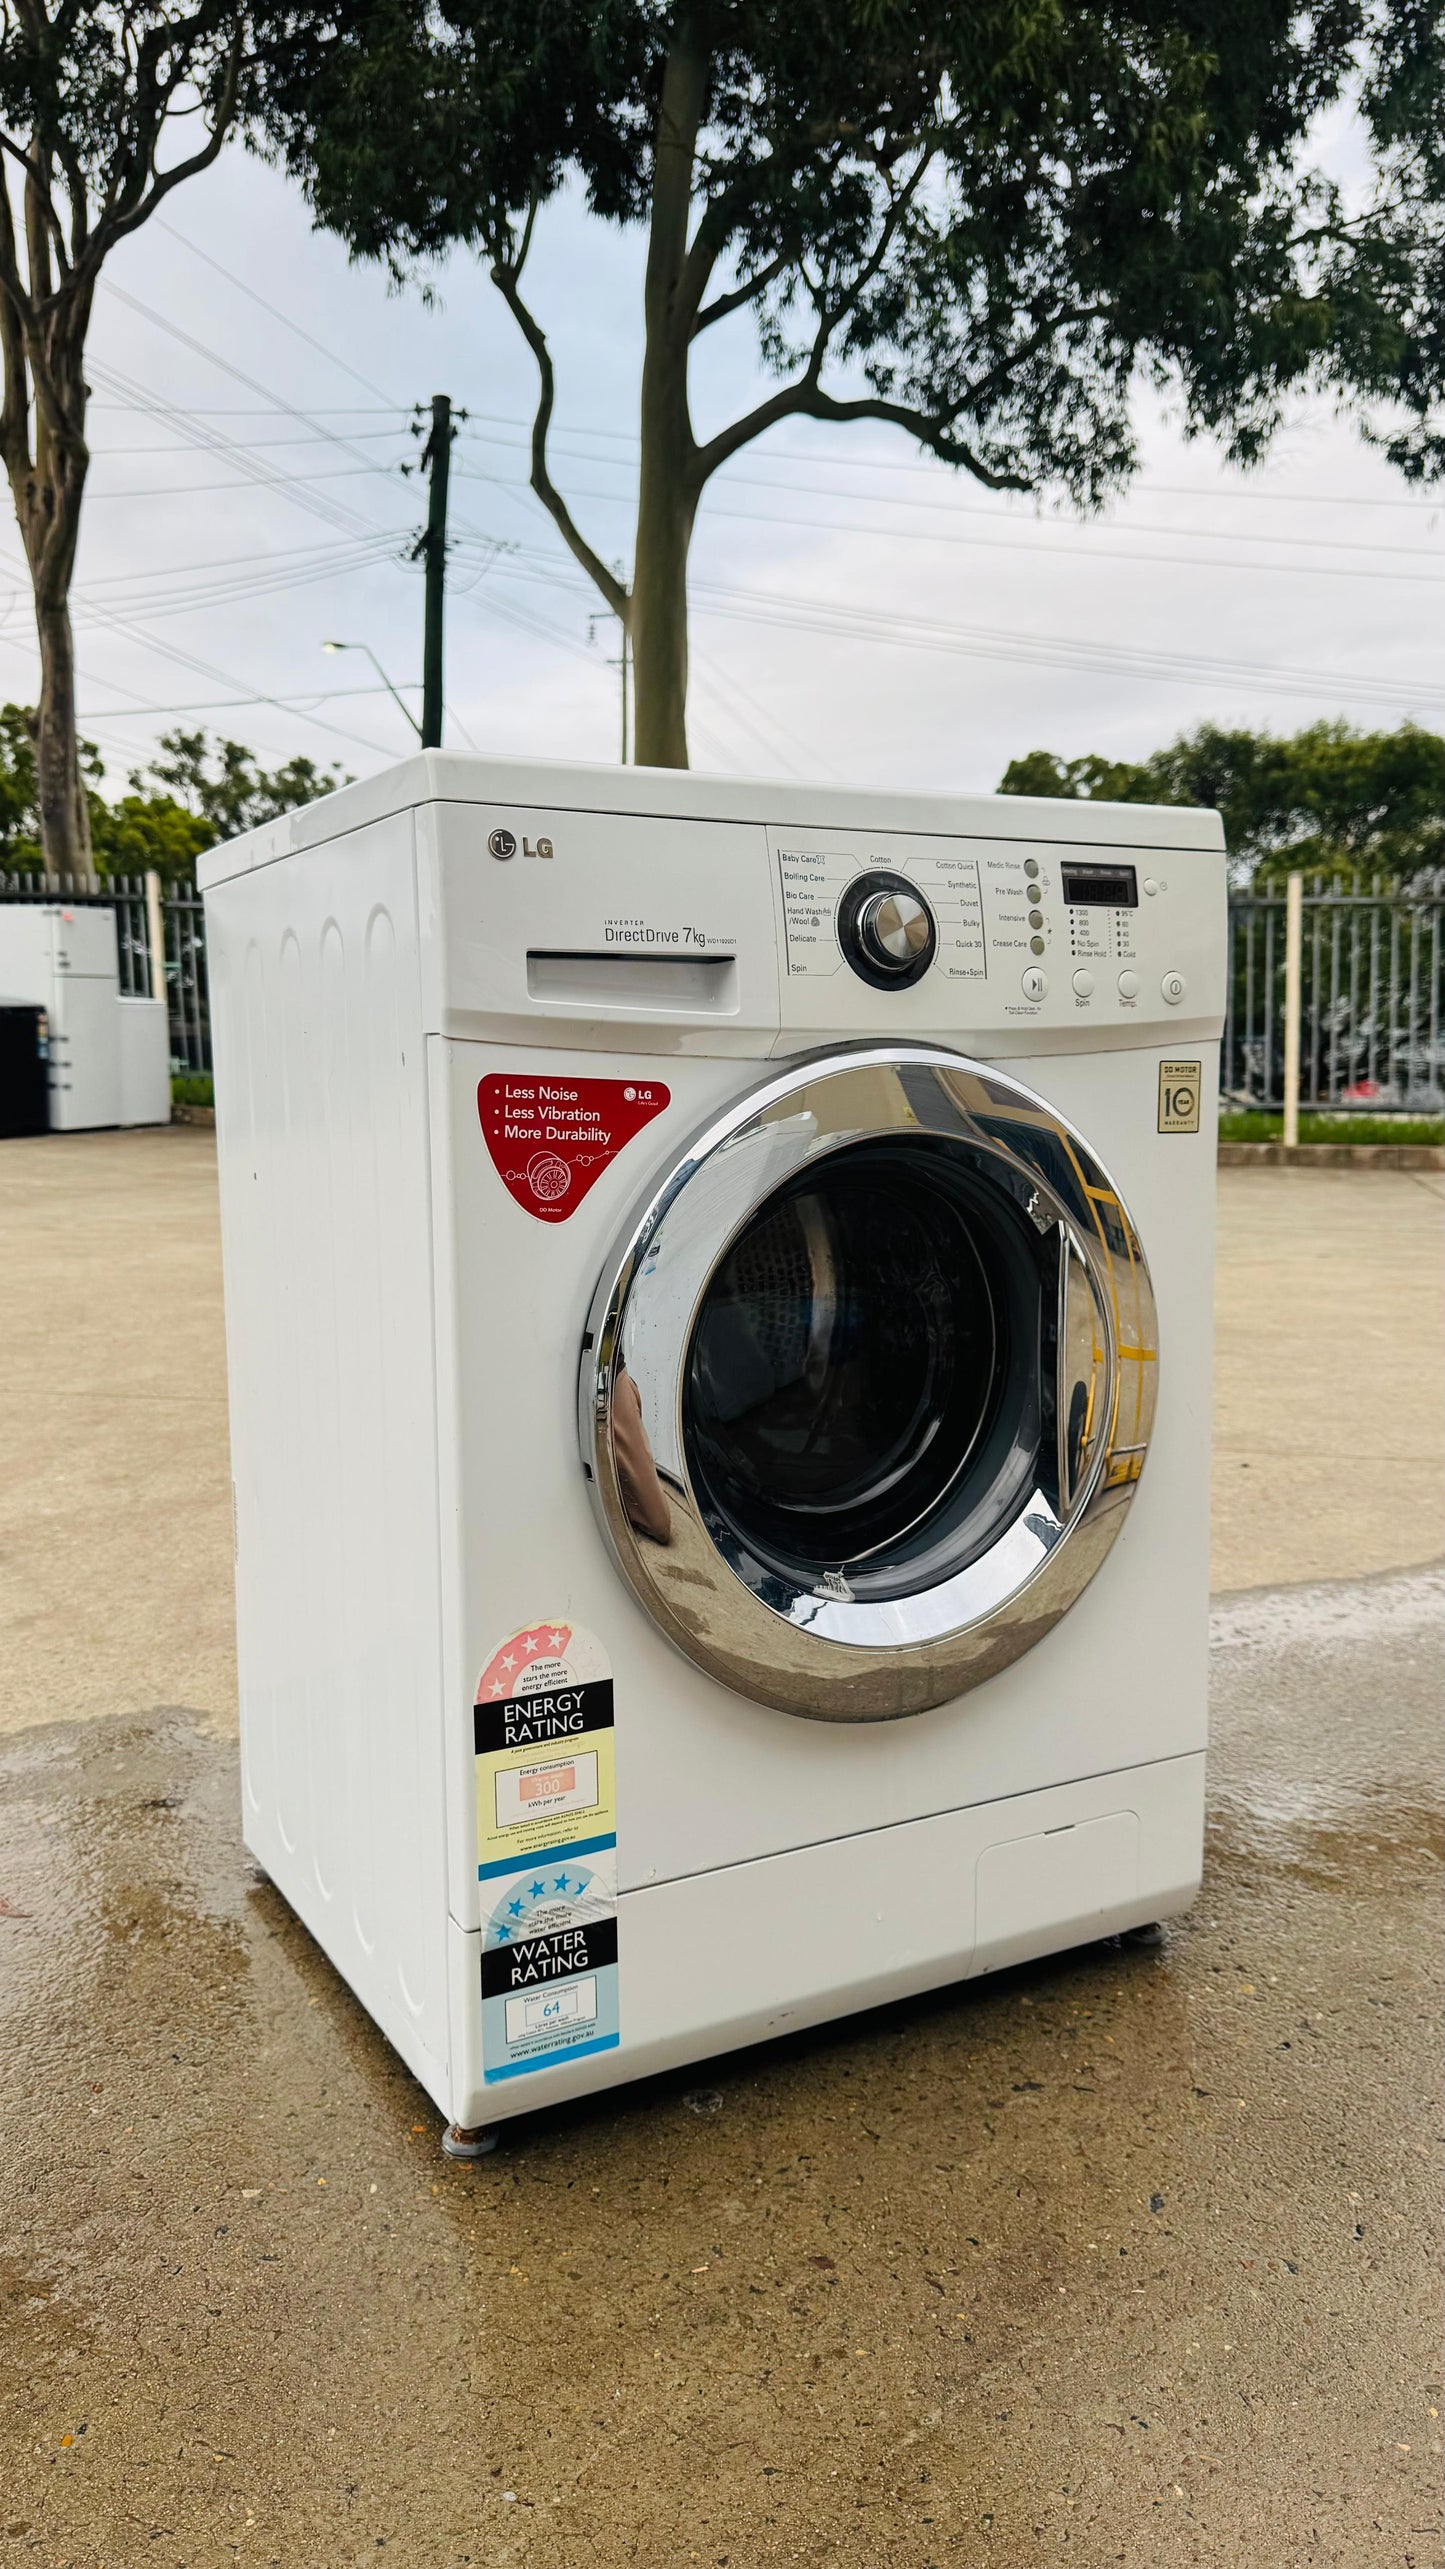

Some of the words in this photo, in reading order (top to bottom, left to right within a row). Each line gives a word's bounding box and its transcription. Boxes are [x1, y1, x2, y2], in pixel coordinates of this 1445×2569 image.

[522, 836, 554, 858] LG
[782, 854, 799, 864] Baby
[800, 855, 816, 863] Care
[870, 855, 892, 863] Cotton
[936, 861, 956, 870] Cotton
[987, 861, 1004, 869] Medic
[784, 872, 808, 882] Boiling
[809, 874, 825, 882] Care
[948, 881, 977, 889] Synthetic
[786, 891, 797, 899] Bio
[798, 892, 814, 900] Care
[963, 919, 980, 928] Bulky
[790, 934, 817, 942] Delicate
[992, 939, 1013, 947] Crease
[956, 940, 973, 948] Quick
[974, 940, 982, 948] 30
[1087, 940, 1099, 948] Spin
[1123, 950, 1136, 958] Cold
[791, 964, 807, 972] Spin
[1075, 998, 1090, 1008] Spin
[505, 1085, 535, 1099] Less
[539, 1086, 578, 1101] Noise
[638, 1090, 652, 1100] LG
[1164, 1087, 1195, 1117] 10
[505, 1105, 535, 1119] Less
[538, 1106, 600, 1122] Vibration
[504, 1125, 542, 1139] More
[546, 1127, 611, 1145] Durability
[522, 1683, 542, 1691] energy
[544, 1678, 568, 1687] efficient
[504, 1691, 585, 1723] ENERGY
[506, 1713, 584, 1745] RATING
[520, 1767, 538, 1776] Energy
[540, 1760, 574, 1772] consumption
[536, 1779, 560, 1796] 300
[543, 1798, 552, 1806] per
[529, 1926, 546, 1934] water
[512, 1930, 587, 1963] WATER
[511, 1950, 588, 1985] RATING
[542, 1984, 578, 1998] Consumption
[544, 2000, 560, 2017] 64
[510, 2031, 594, 2058] www.waterrating.gov.au
